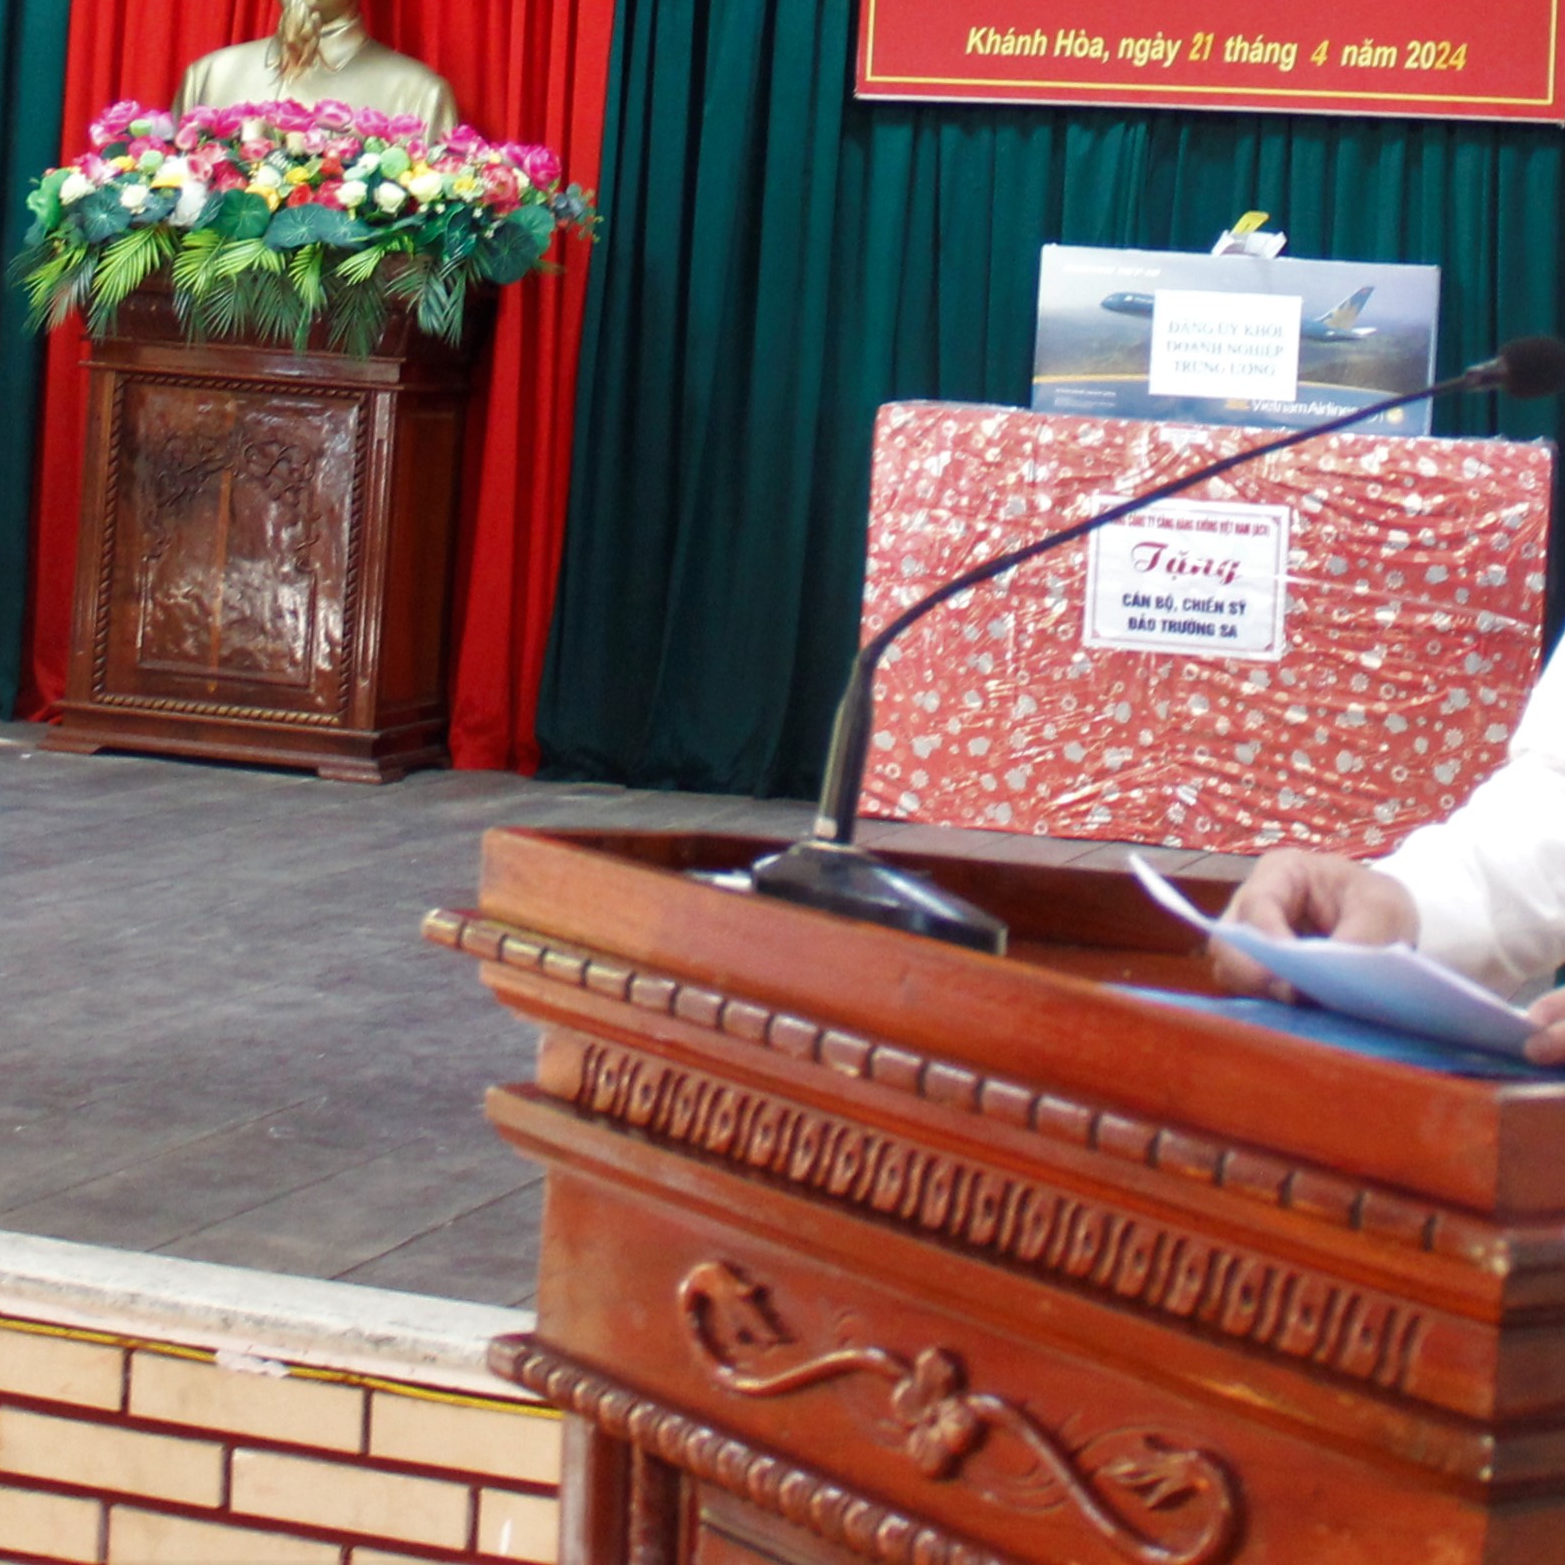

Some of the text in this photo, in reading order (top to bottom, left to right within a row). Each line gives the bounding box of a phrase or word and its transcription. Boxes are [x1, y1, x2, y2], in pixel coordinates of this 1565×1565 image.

[965, 26, 1468, 73] Khánh Hòa, ngày 21 tháng 4 năm 2024
[1131, 541, 1242, 585] Tặng
[1122, 591, 1151, 609] CÁN
[1183, 596, 1225, 614] CHIẾN
[1220, 623, 1238, 638] SA
